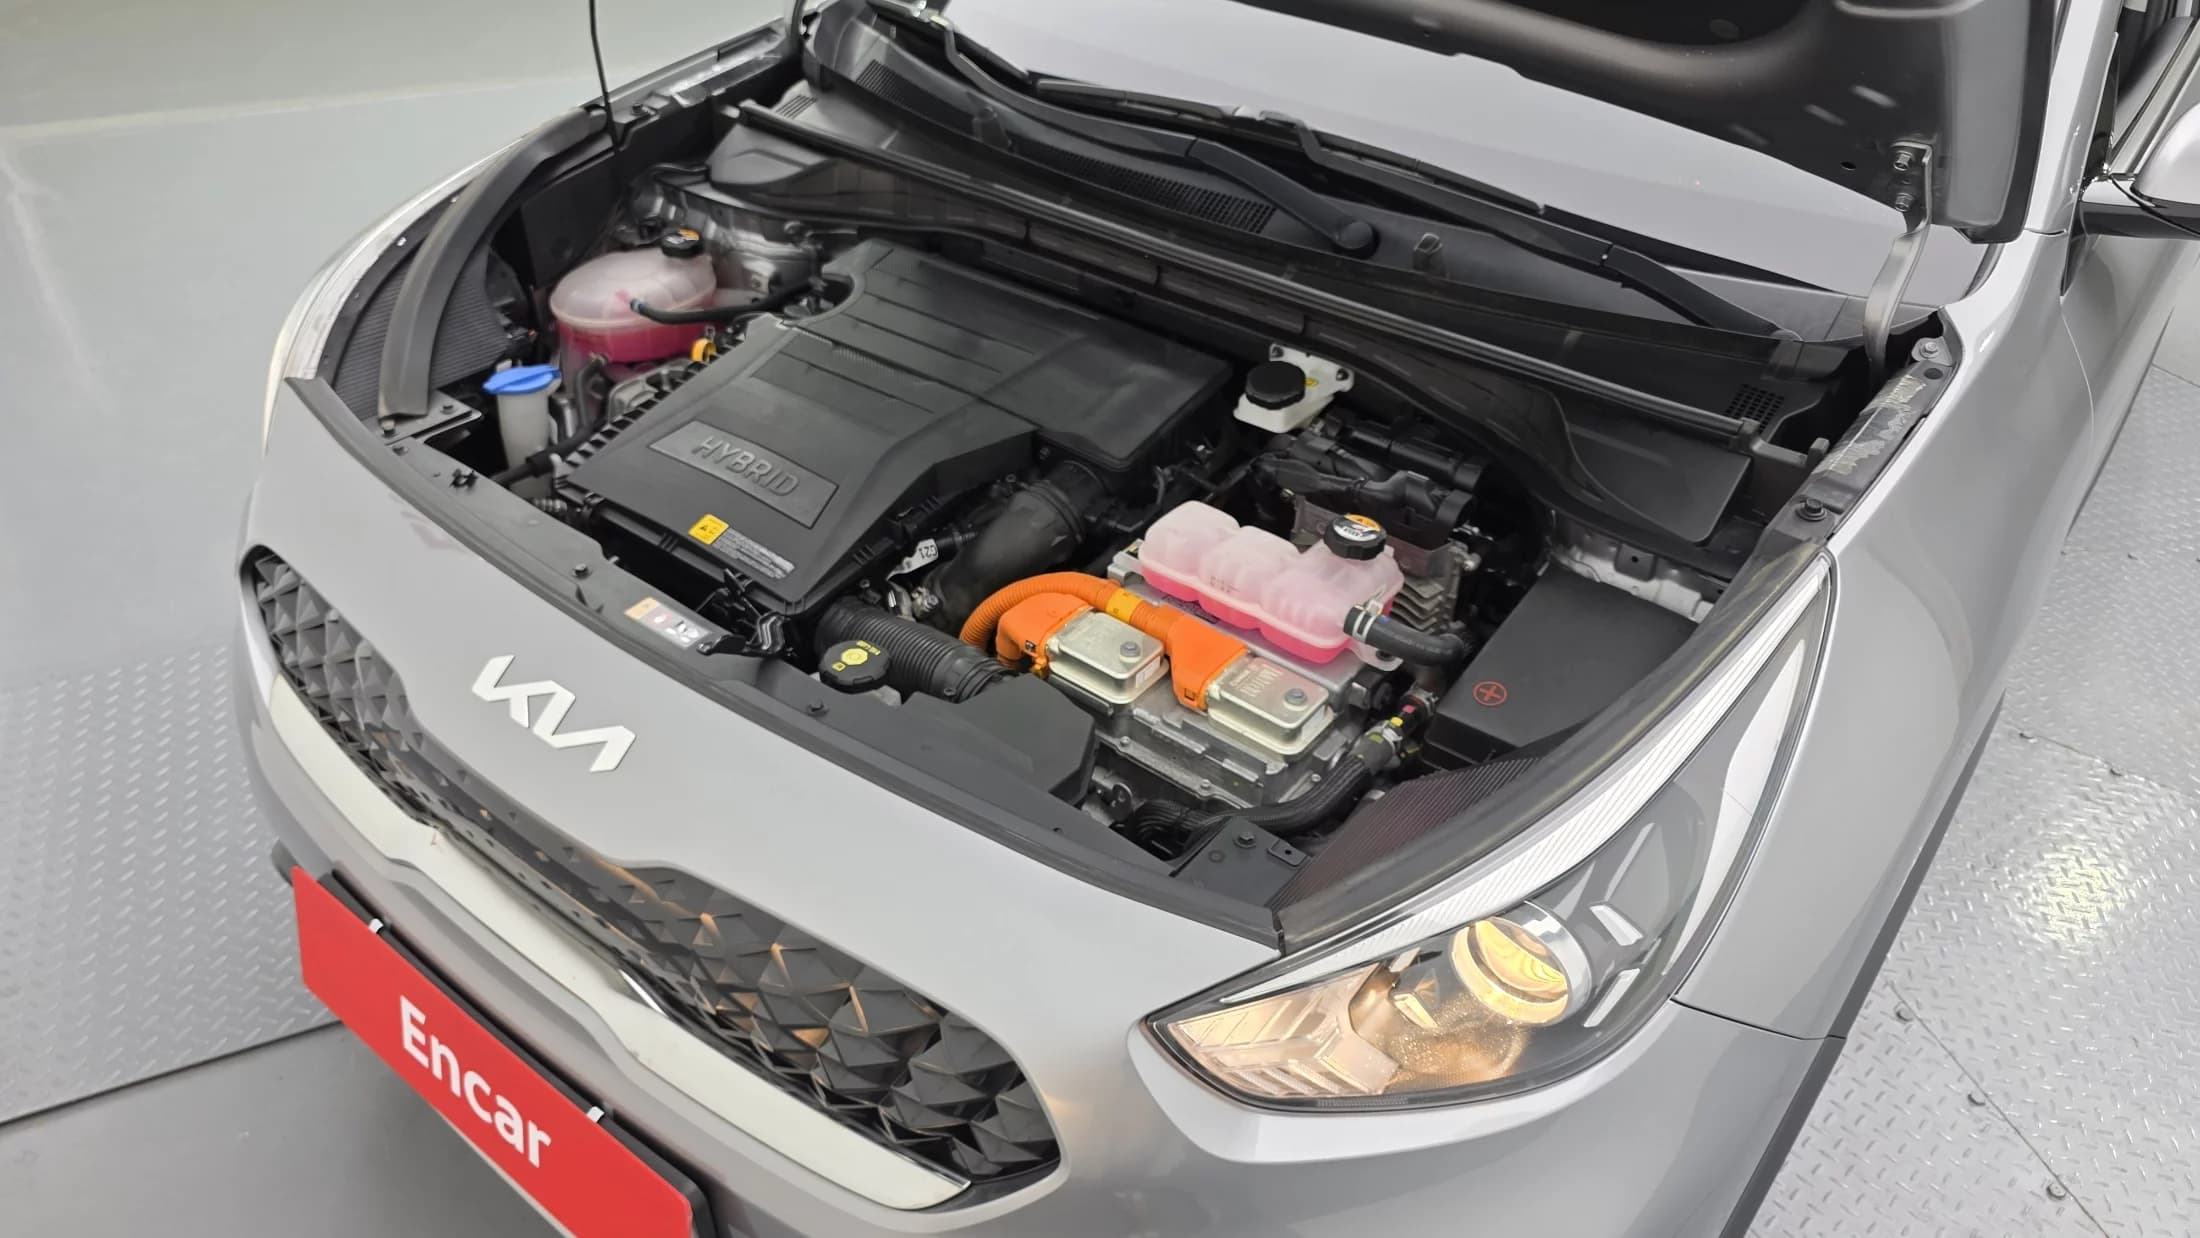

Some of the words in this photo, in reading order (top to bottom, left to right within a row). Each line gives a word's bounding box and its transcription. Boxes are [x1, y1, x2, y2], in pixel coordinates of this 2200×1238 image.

[691, 435, 801, 497] HYBRID
[472, 654, 637, 774] KIA
[400, 994, 552, 1169] Encar
